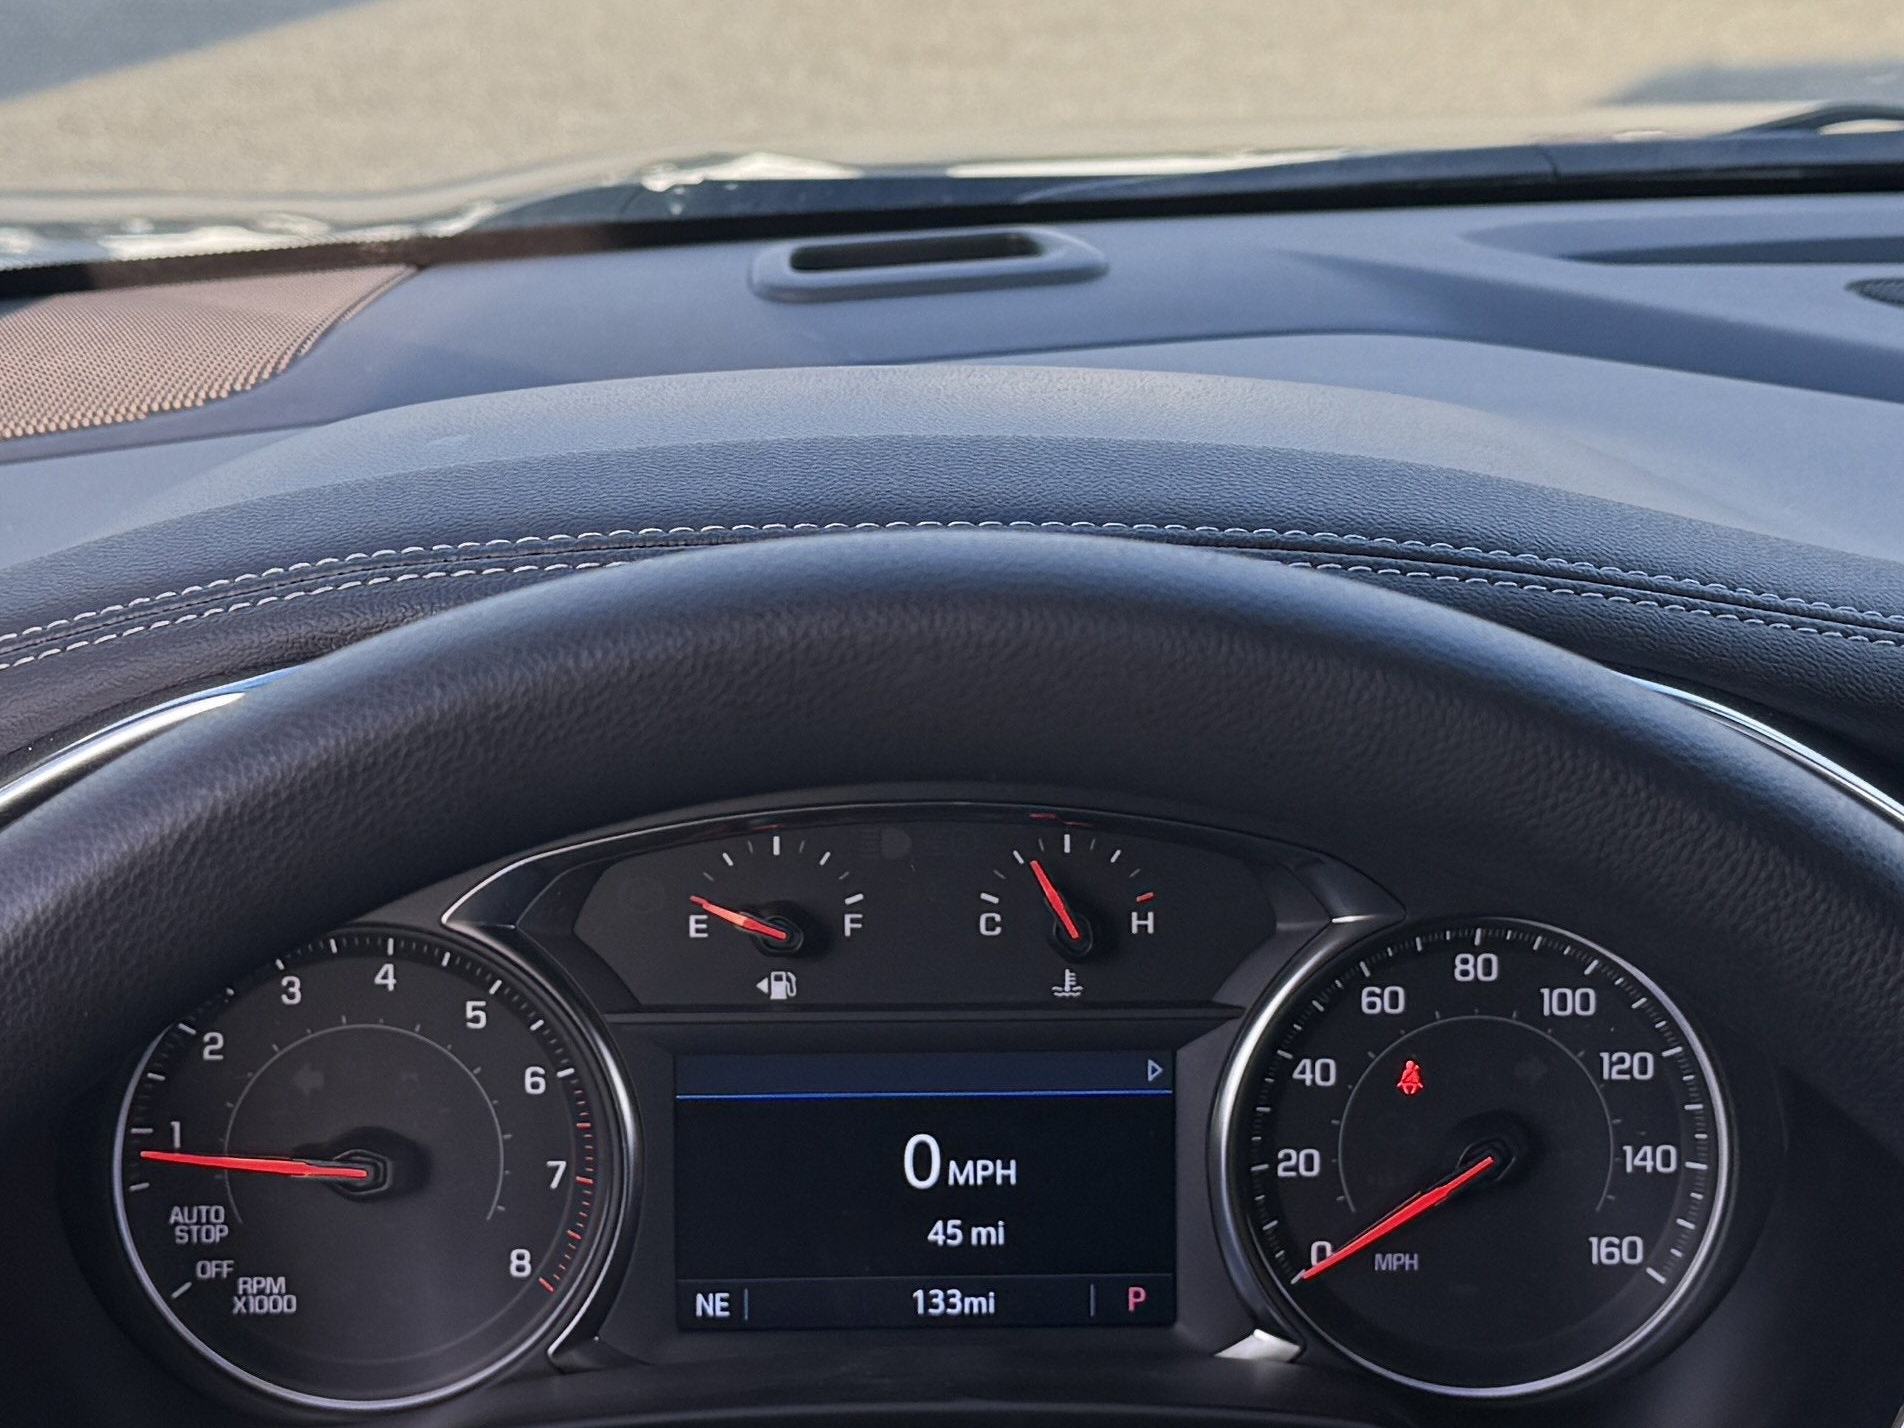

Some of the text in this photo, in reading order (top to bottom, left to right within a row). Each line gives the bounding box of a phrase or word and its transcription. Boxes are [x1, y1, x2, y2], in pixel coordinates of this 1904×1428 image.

[688, 914, 709, 939] E
[843, 913, 863, 937] F
[978, 913, 1002, 937] C
[1131, 912, 1154, 935] H
[374, 963, 397, 991] 4
[1453, 953, 1499, 982] 80
[280, 976, 302, 1005] 3
[1360, 986, 1405, 1015] 60
[1540, 987, 1596, 1016] 100
[465, 999, 487, 1029] 5
[201, 1032, 225, 1061] 2
[1292, 1058, 1337, 1087] 40
[1599, 1051, 1654, 1081] 120
[524, 1066, 547, 1095] 6
[169, 1120, 182, 1149] 1
[902, 1133, 1017, 1190] 0 MPH
[1276, 1149, 1321, 1178] 20
[1622, 1144, 1677, 1174] 140
[545, 1159, 569, 1189] 7
[169, 1205, 226, 1226] AUTO
[174, 1224, 229, 1244] STOP
[927, 1220, 1005, 1246] 45 mi
[510, 1248, 532, 1277] 8
[1310, 1240, 1333, 1267] 0
[1374, 1253, 1419, 1272] MPH
[1588, 1236, 1644, 1265] 160
[196, 1260, 234, 1279] OFF
[237, 1276, 287, 1295] RPM
[1127, 1287, 1146, 1312] P
[233, 1294, 297, 1315] X1000
[696, 1292, 731, 1317] NE
[912, 1288, 996, 1316] 133mi
